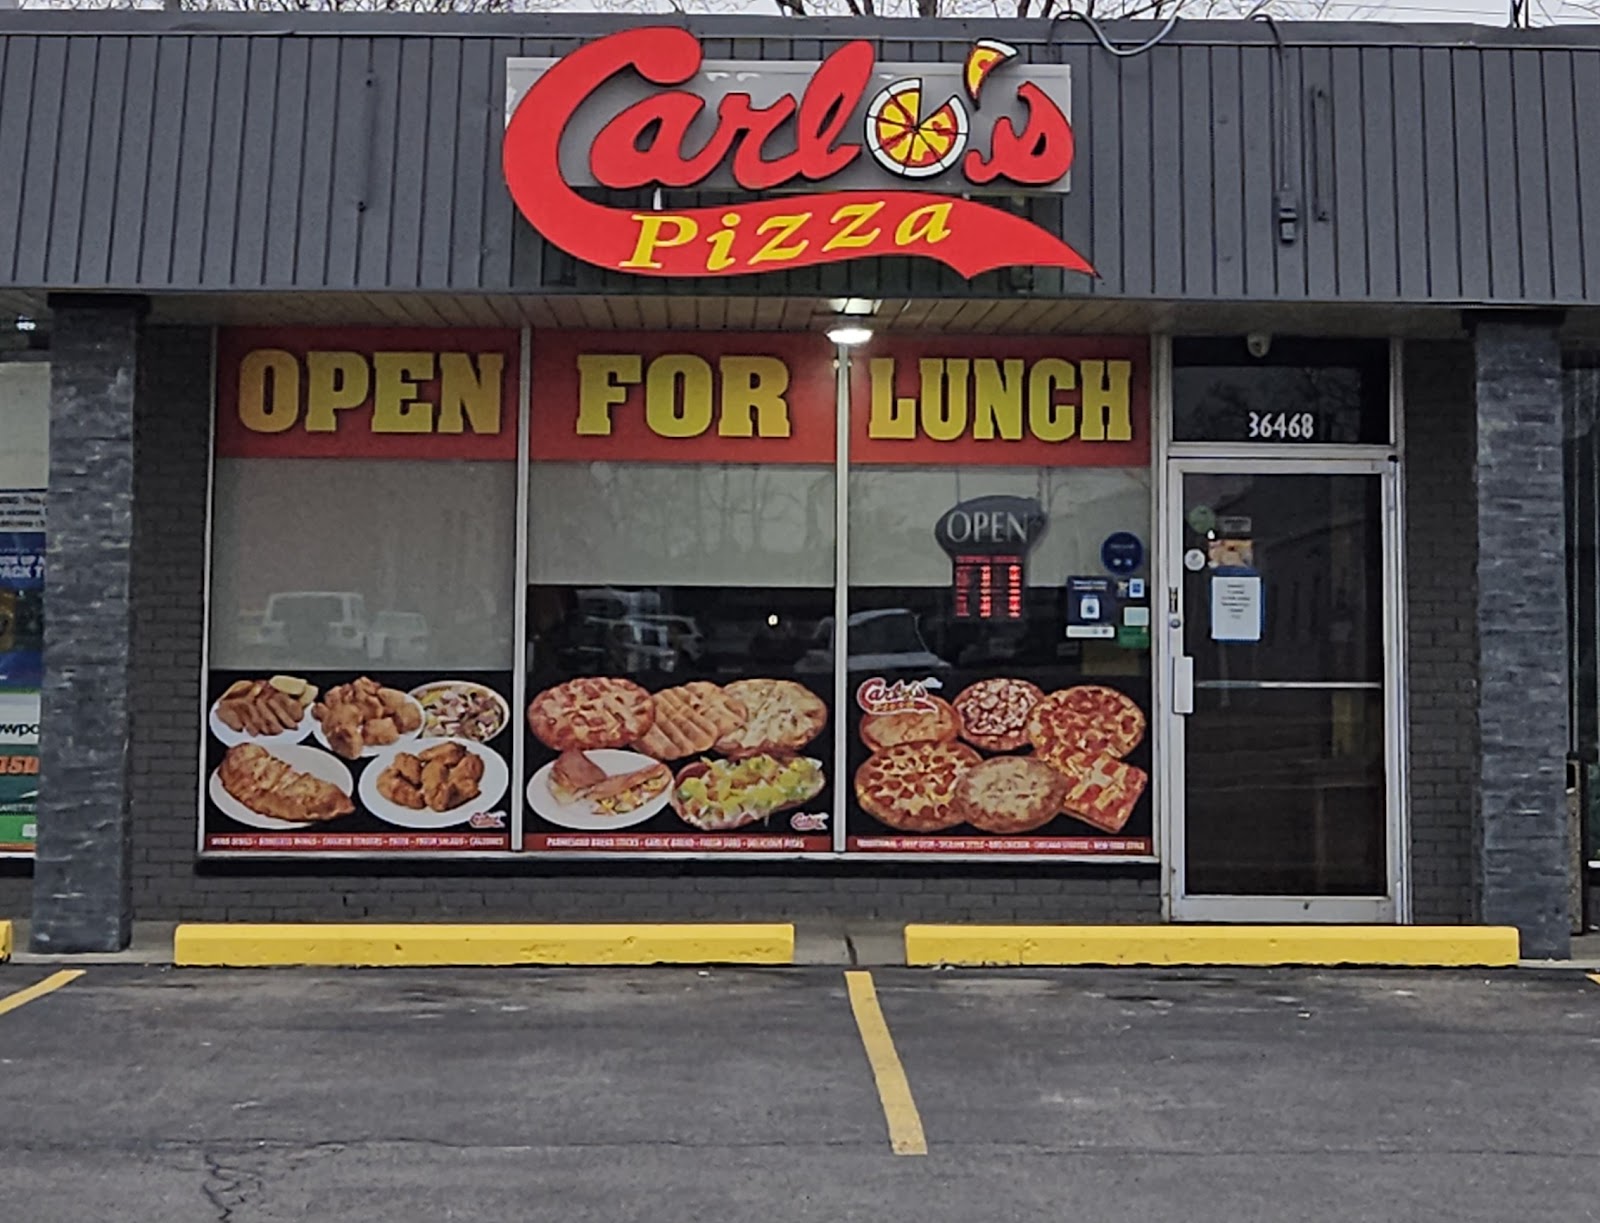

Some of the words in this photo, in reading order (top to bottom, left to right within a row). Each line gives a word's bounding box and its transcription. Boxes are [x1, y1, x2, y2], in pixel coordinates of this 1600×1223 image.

[503, 26, 1075, 205] Carlo's
[618, 200, 953, 271] Pizza
[237, 348, 503, 434] OPEN
[575, 353, 791, 438] FOR
[868, 357, 1133, 442] LUNCH
[1248, 411, 1314, 439] 36468
[946, 510, 1029, 543] OPEN
